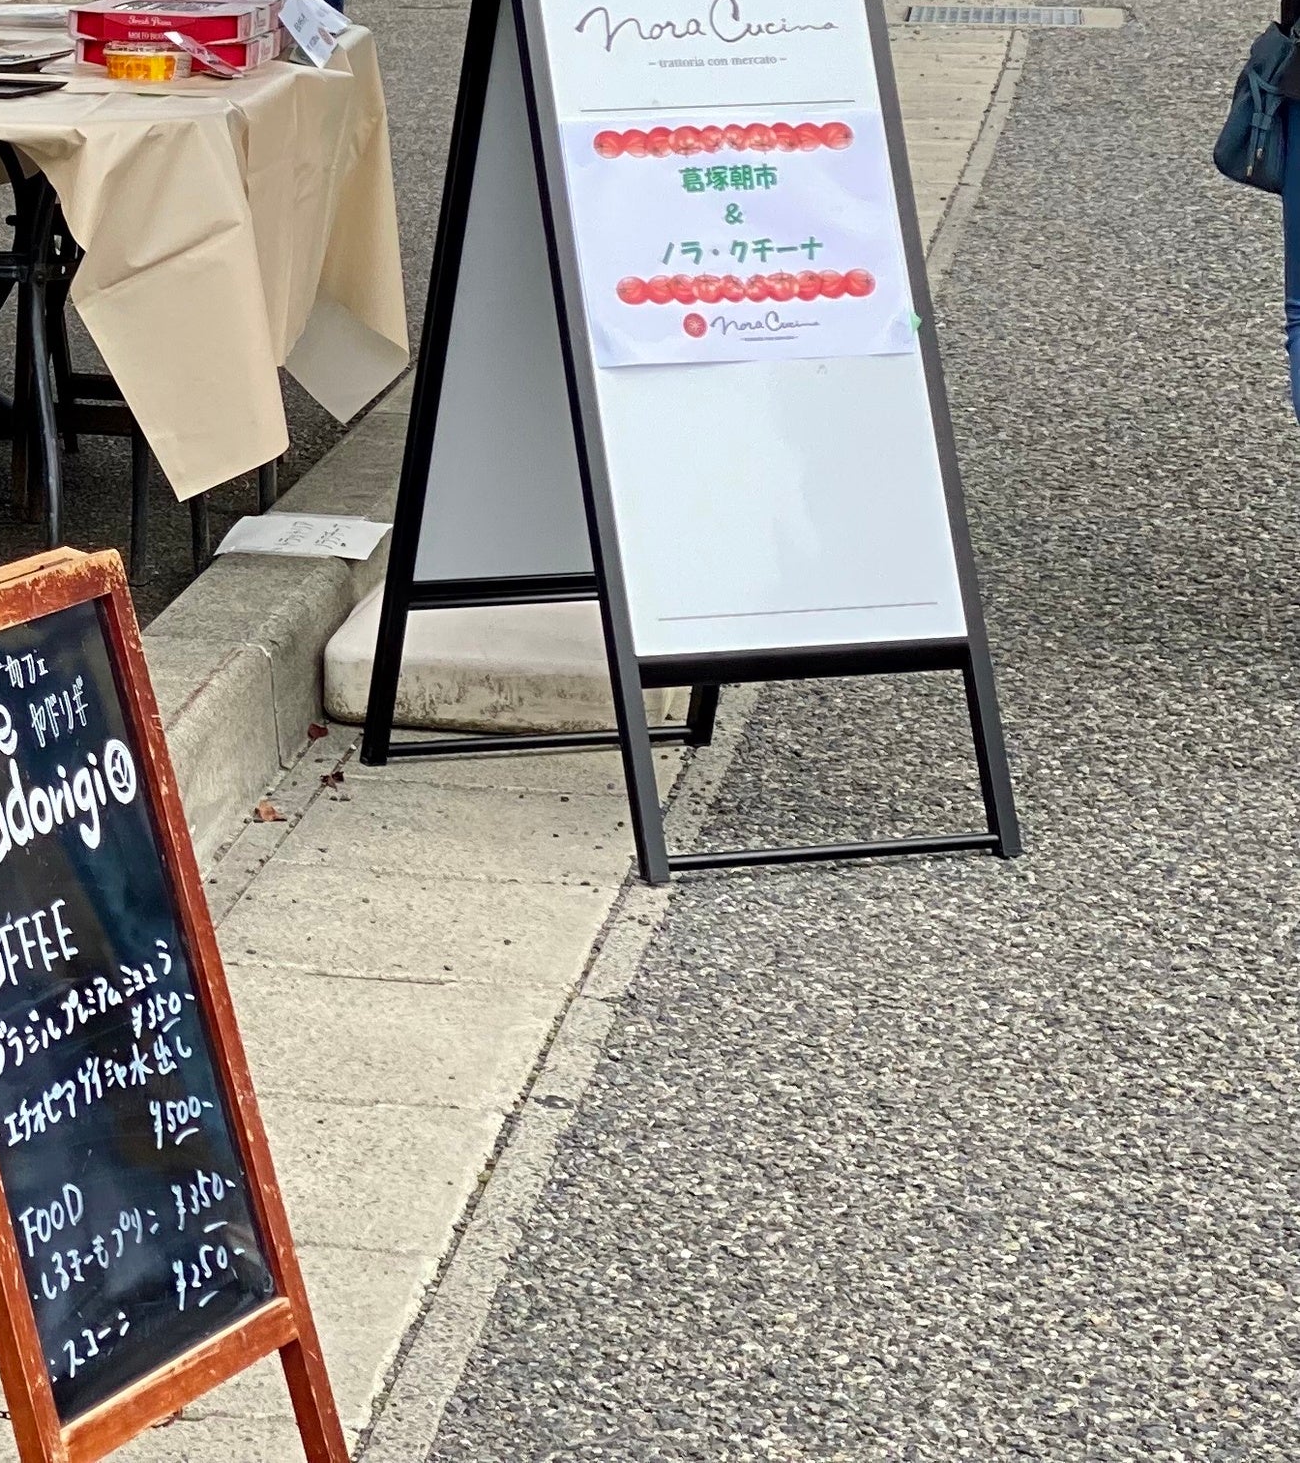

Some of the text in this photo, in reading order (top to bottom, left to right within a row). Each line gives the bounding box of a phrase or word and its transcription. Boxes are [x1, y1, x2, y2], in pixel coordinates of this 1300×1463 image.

[707, 56, 729, 67] con
[731, 55, 778, 67] mercato
[679, 163, 778, 193] 葛塚朝市
[724, 202, 745, 226] &
[661, 236, 824, 266] ノラ・クチーナ
[28, 674, 89, 748] ヤドリギ
[18, 1182, 85, 1258] FOOD
